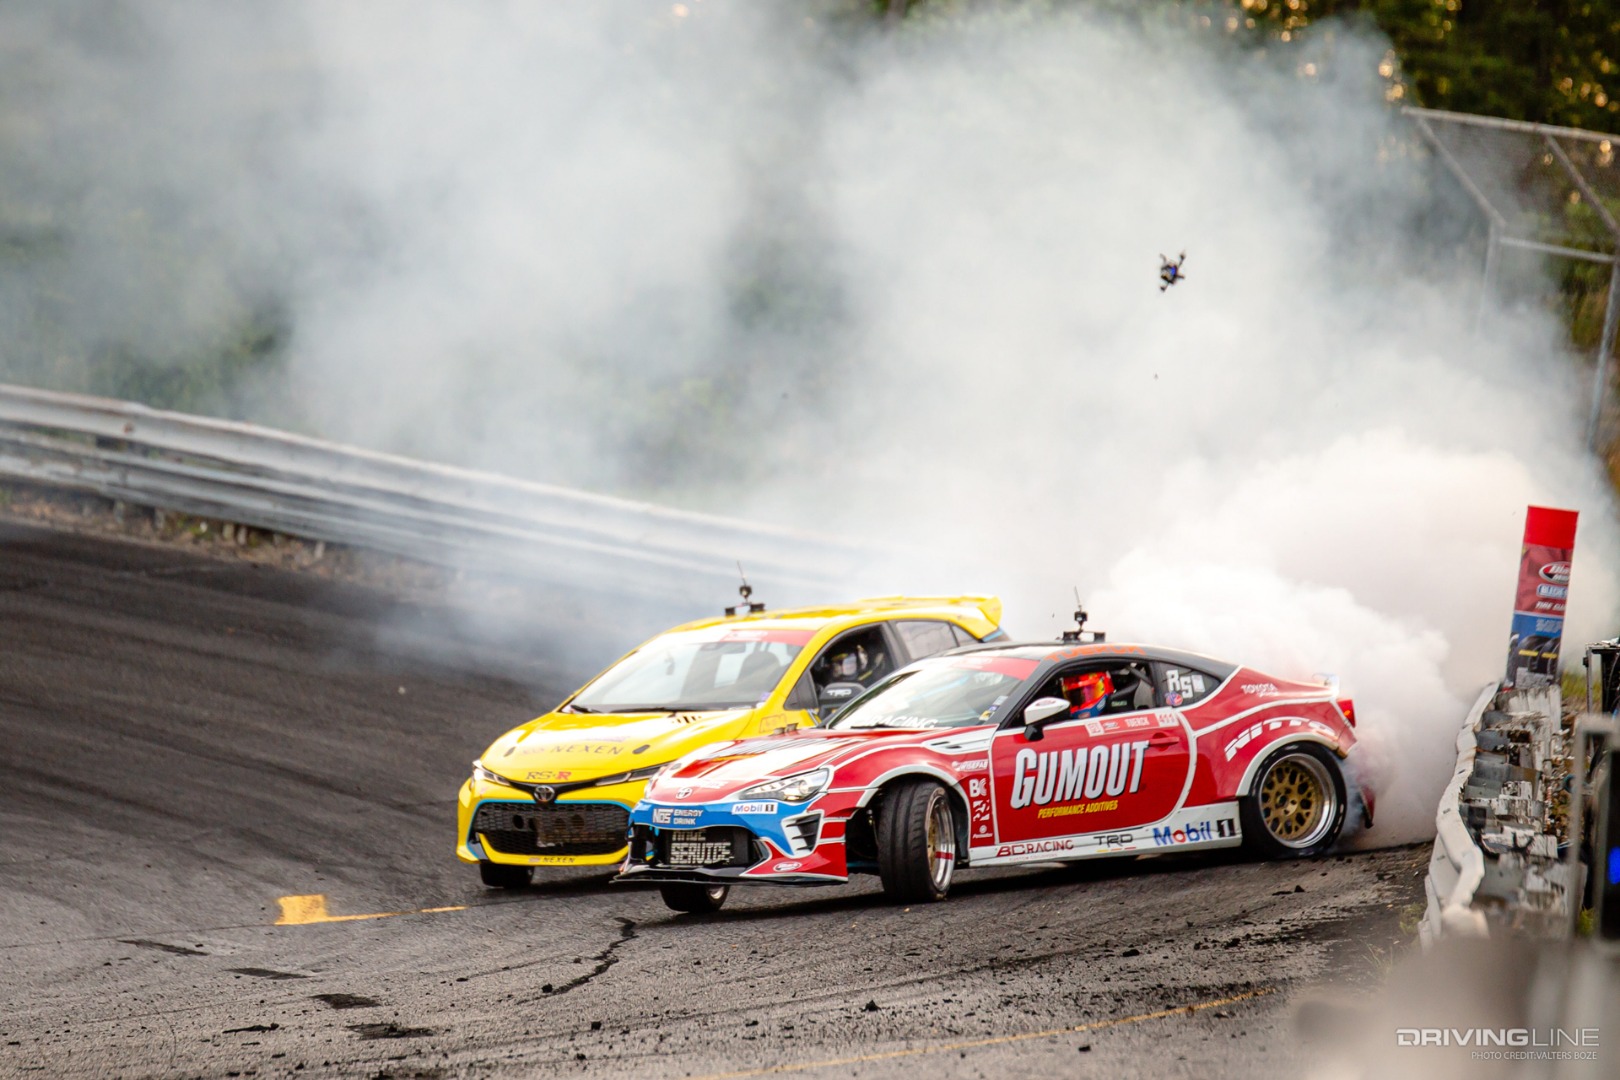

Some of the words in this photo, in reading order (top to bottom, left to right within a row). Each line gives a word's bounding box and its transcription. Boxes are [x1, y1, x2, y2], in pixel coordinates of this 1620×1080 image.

[550, 744, 625, 755] NEXEN
[1010, 739, 1150, 810] GUMOUT
[652, 808, 674, 824] NOS
[673, 809, 704, 817] ENERGY
[735, 805, 763, 813] Mobil
[1037, 804, 1085, 819] PERFORMANCE
[1085, 800, 1119, 814] ADDITIVES
[1093, 833, 1134, 847] TRD
[1152, 821, 1213, 846] Mobil
